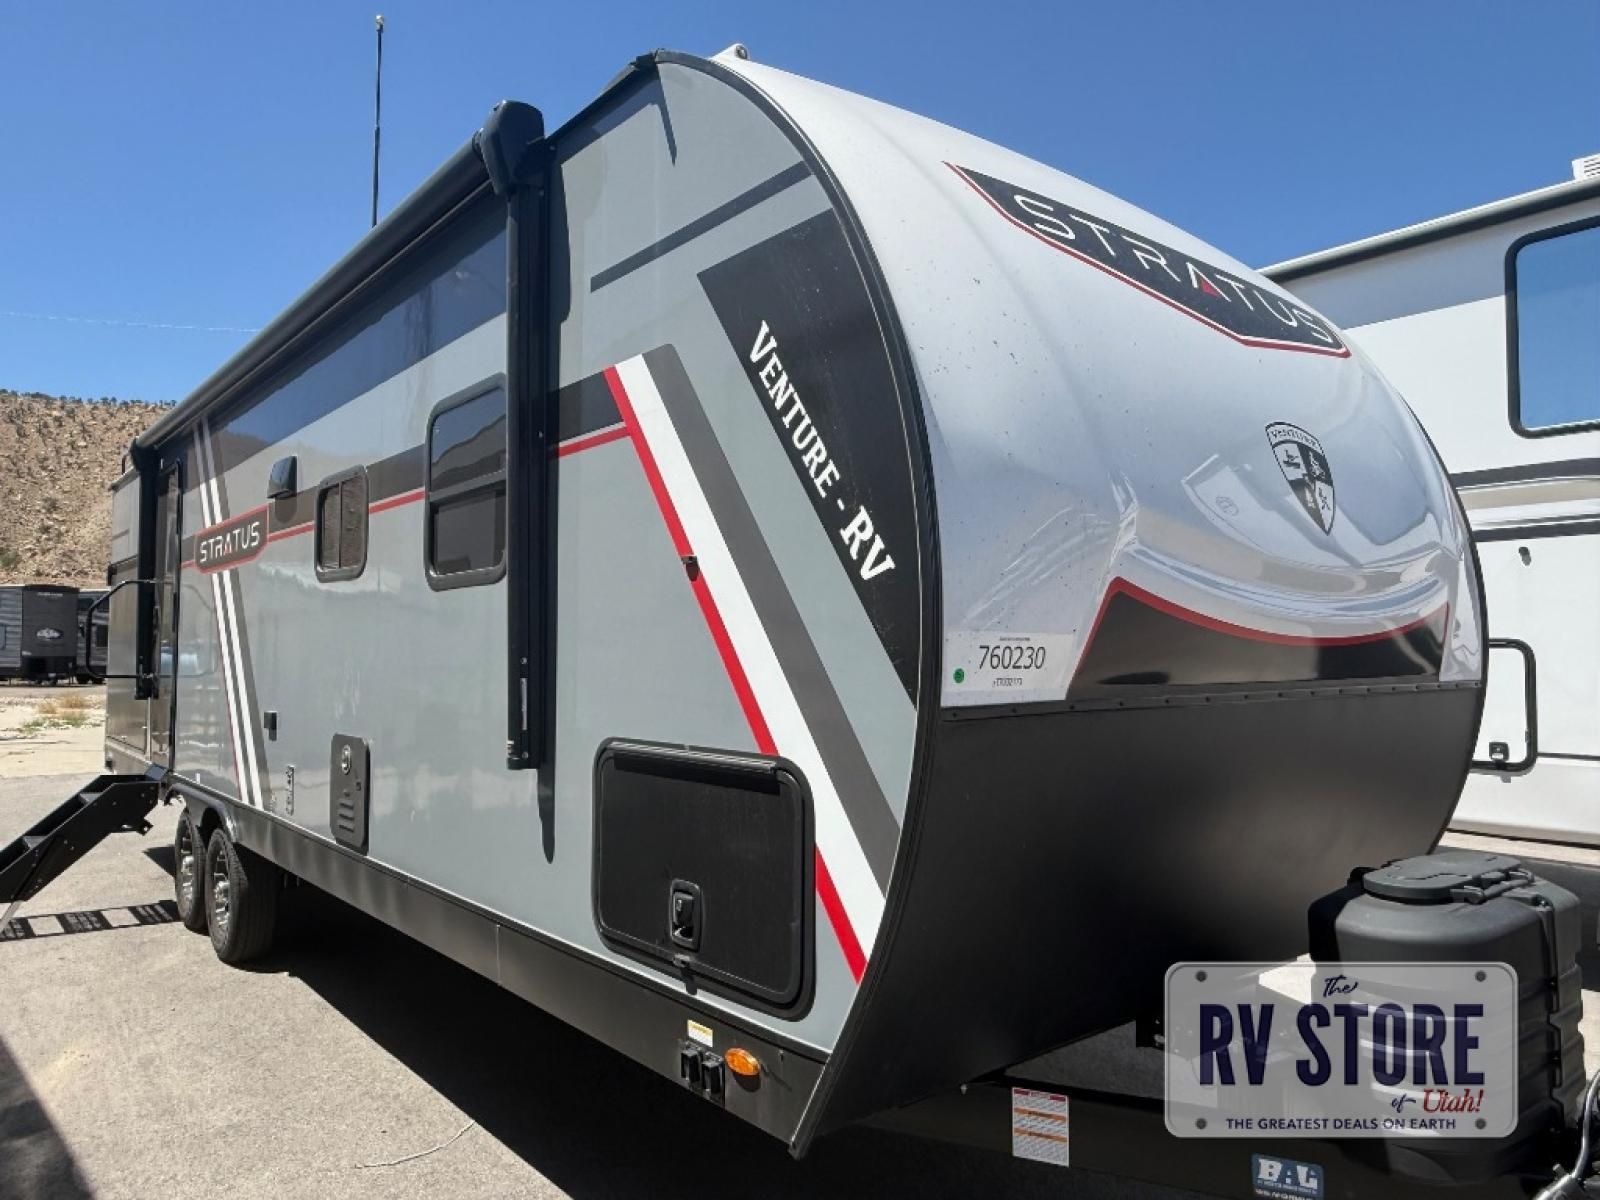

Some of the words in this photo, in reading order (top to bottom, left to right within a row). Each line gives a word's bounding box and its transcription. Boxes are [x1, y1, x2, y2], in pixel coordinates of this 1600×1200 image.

[1013, 194, 1334, 343] STRATUS
[750, 320, 840, 498] VENTURE
[840, 505, 896, 580] RV
[200, 521, 260, 564] STRATUS
[979, 645, 1046, 669] 760230
